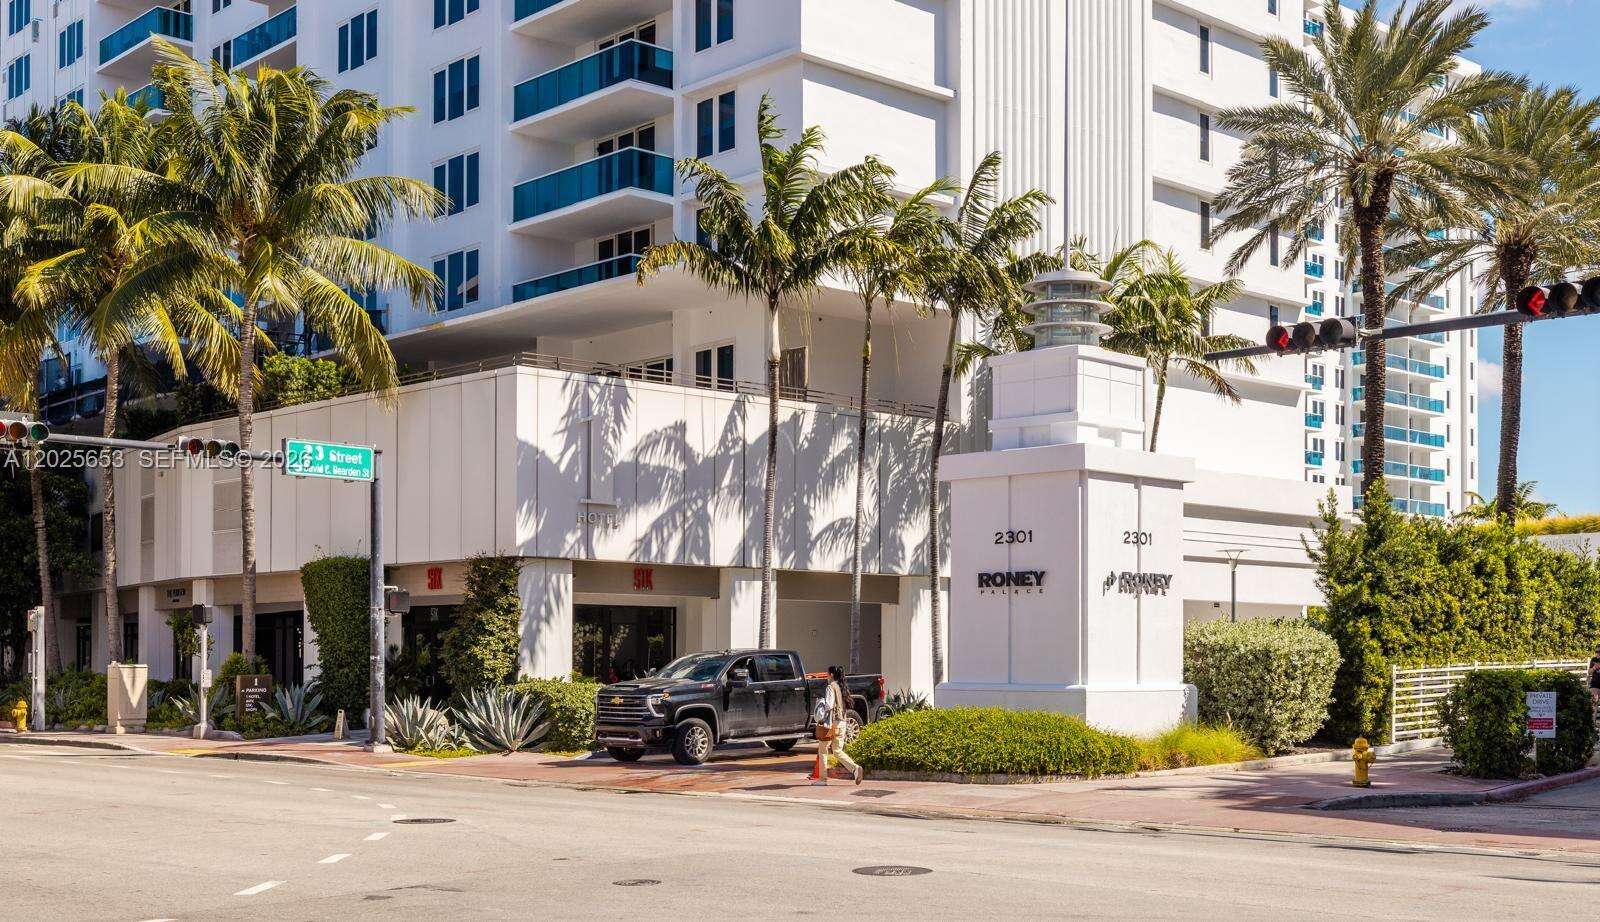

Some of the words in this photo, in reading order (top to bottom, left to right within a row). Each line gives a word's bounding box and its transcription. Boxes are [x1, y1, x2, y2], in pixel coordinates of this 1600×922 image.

[329, 449, 363, 465] Street
[333, 465, 361, 478] Bearden
[994, 529, 1033, 545] 2301
[1123, 531, 1152, 546] 2301
[977, 570, 1046, 588] RONEY
[1119, 571, 1173, 591] RONEY
[980, 588, 1044, 596] PALACE
